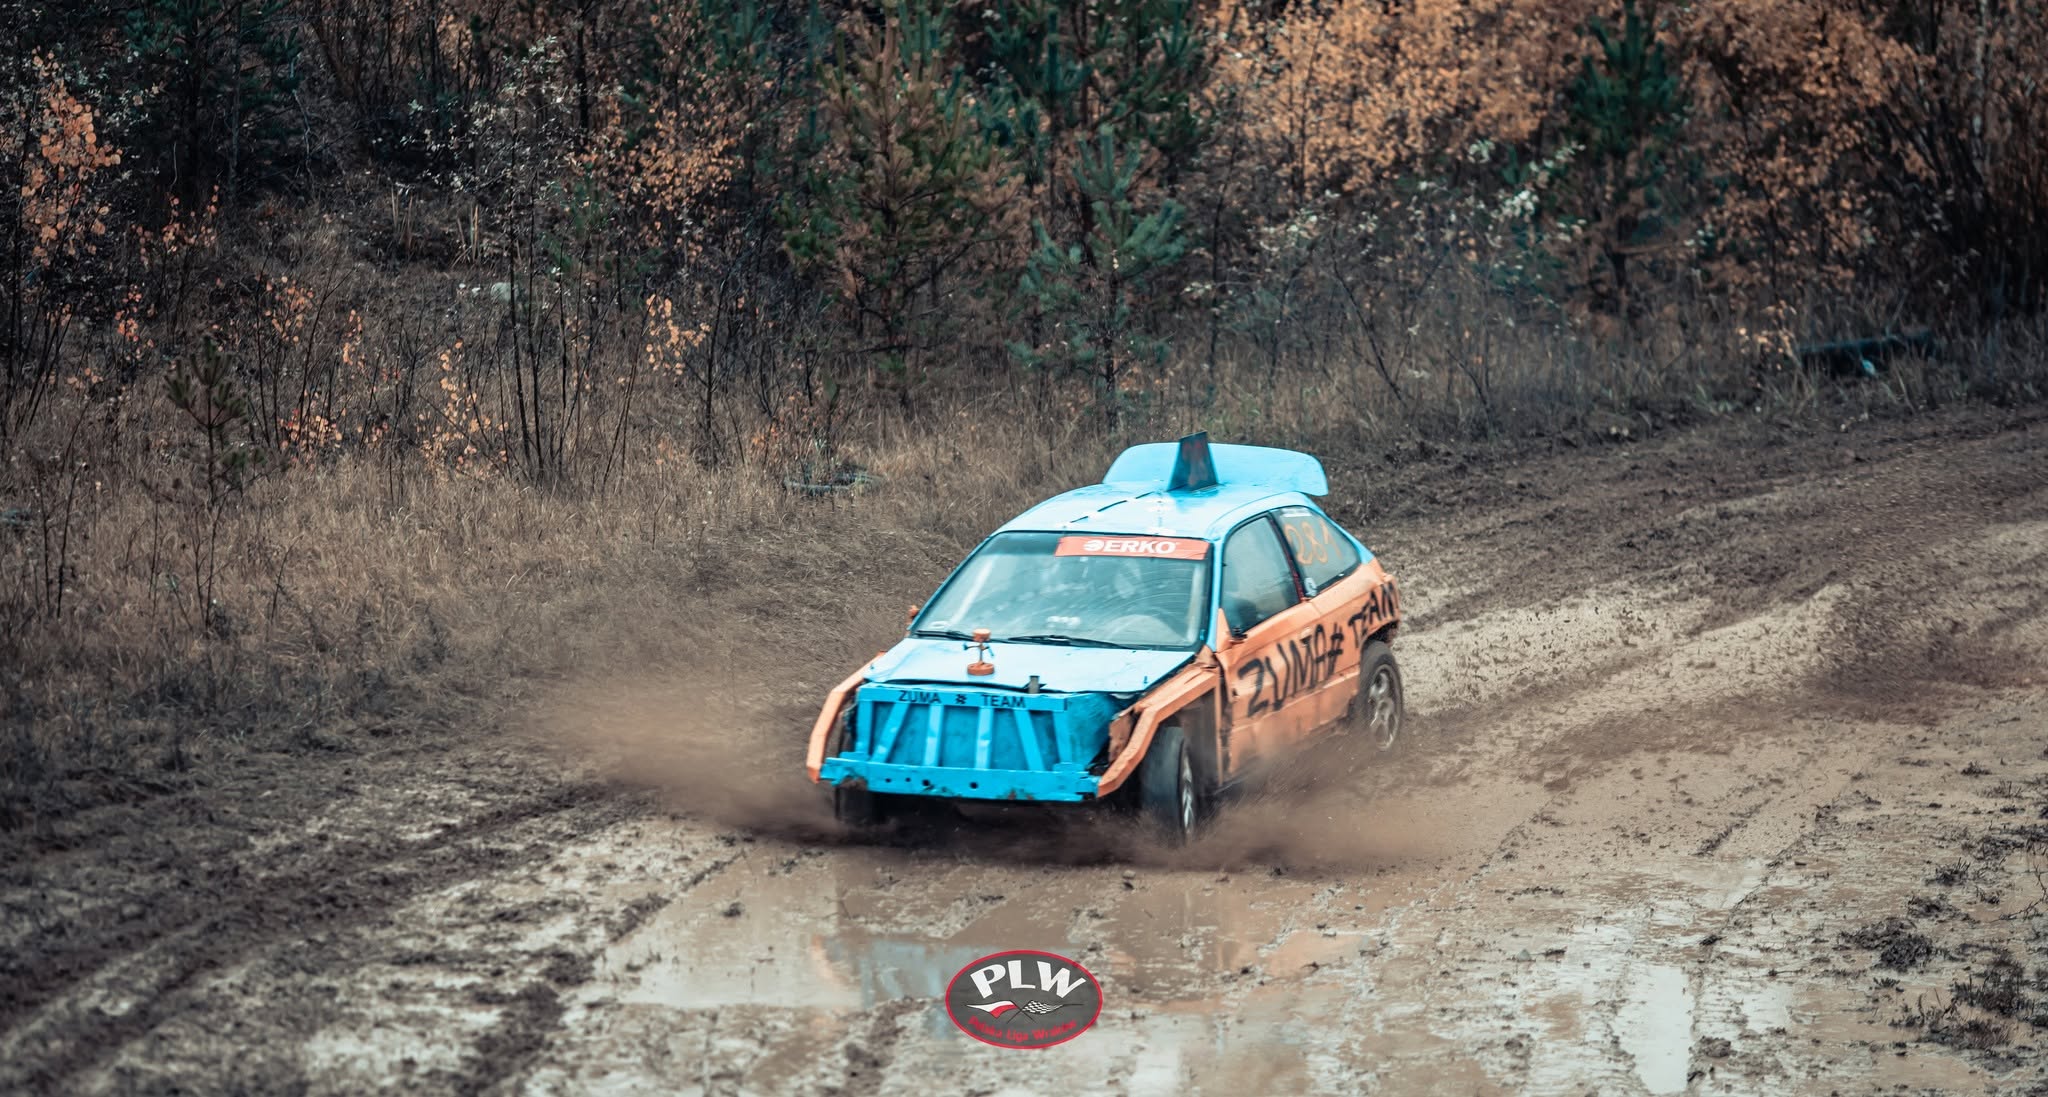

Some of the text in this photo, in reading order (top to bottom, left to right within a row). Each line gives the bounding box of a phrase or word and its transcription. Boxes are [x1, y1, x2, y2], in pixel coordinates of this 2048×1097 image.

[1102, 540, 1176, 554] ERKO
[1284, 519, 1342, 565] 281
[1348, 581, 1399, 649] TEAM
[899, 690, 942, 704] ZUMA
[981, 694, 1026, 708] TEAM
